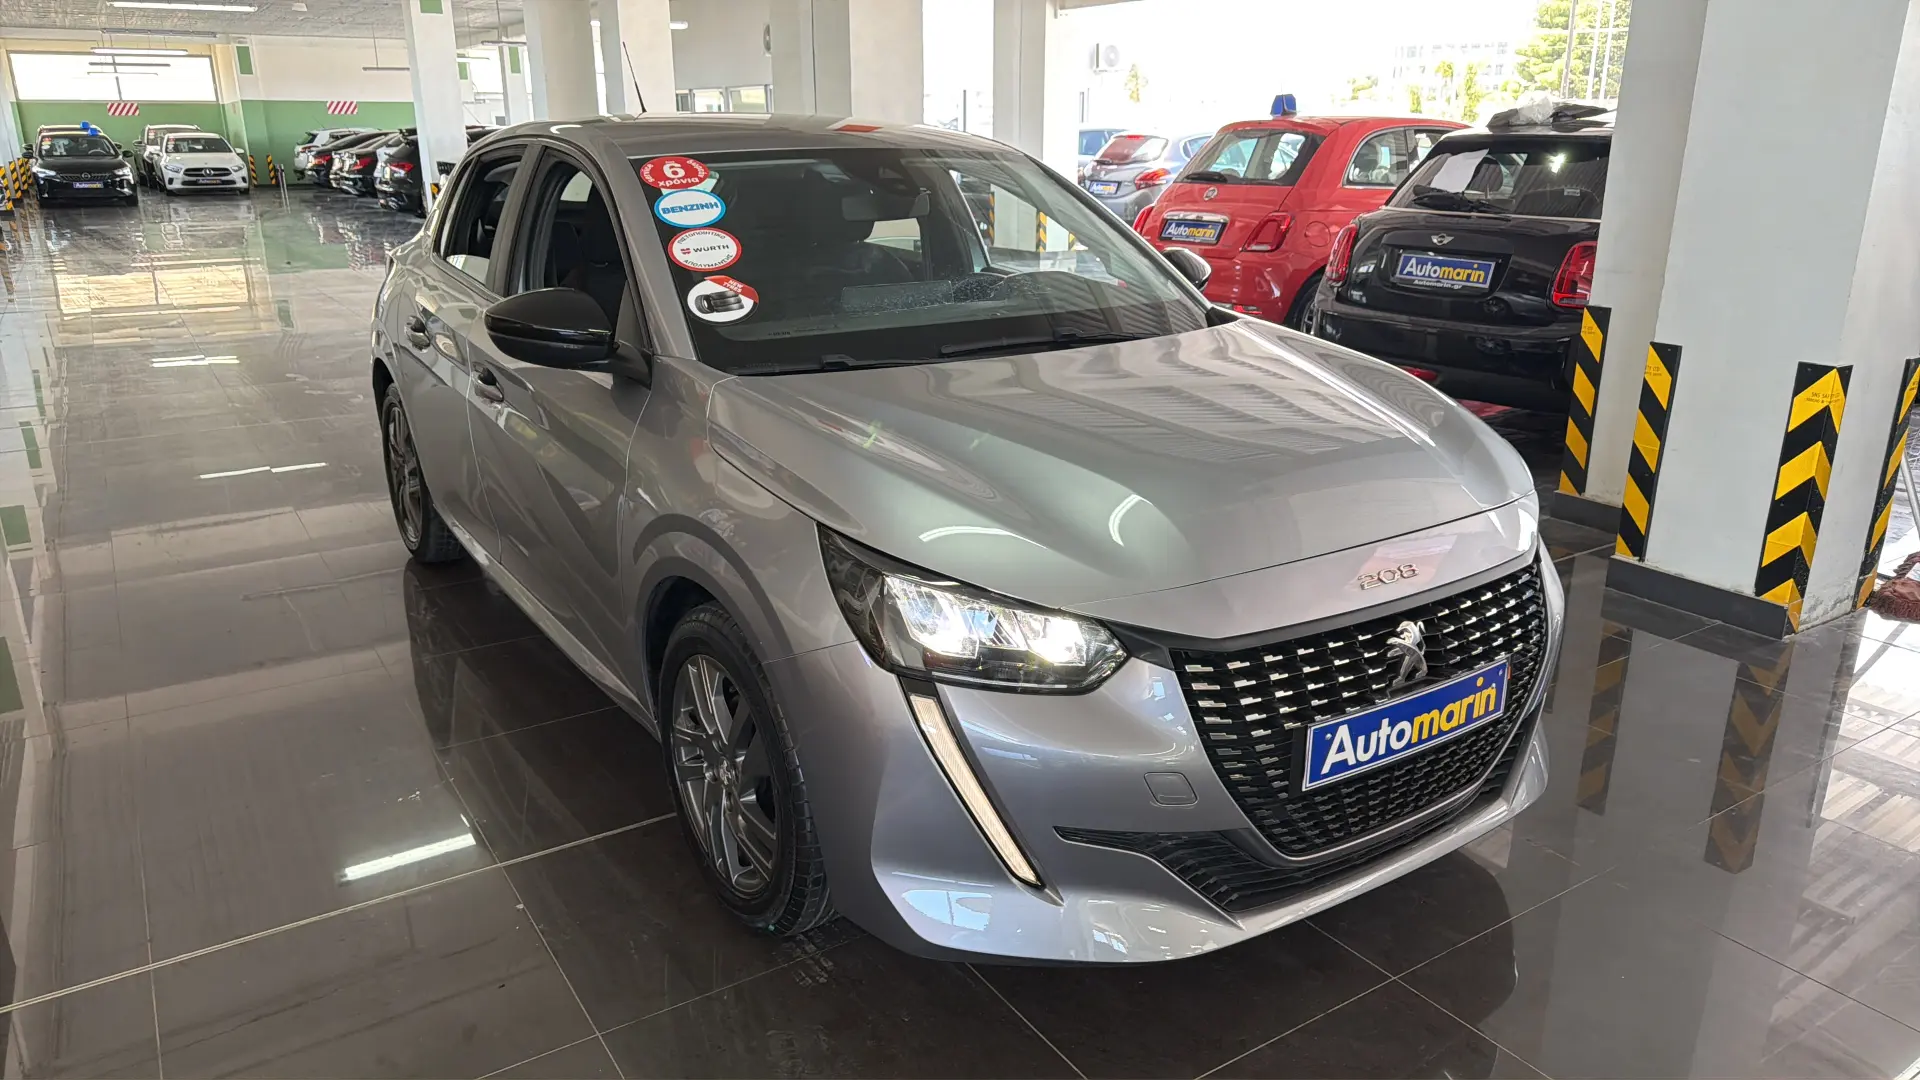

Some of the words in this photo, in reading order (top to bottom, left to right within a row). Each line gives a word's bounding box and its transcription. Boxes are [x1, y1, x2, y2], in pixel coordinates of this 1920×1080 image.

[662, 162, 686, 179] 6
[657, 177, 700, 188] χρόνια
[1165, 222, 1215, 238] Automarin
[1402, 257, 1485, 283] Automarin
[1413, 279, 1463, 290] Automarin.gr
[1357, 563, 1420, 591] 208
[1320, 676, 1497, 776] Automarin
